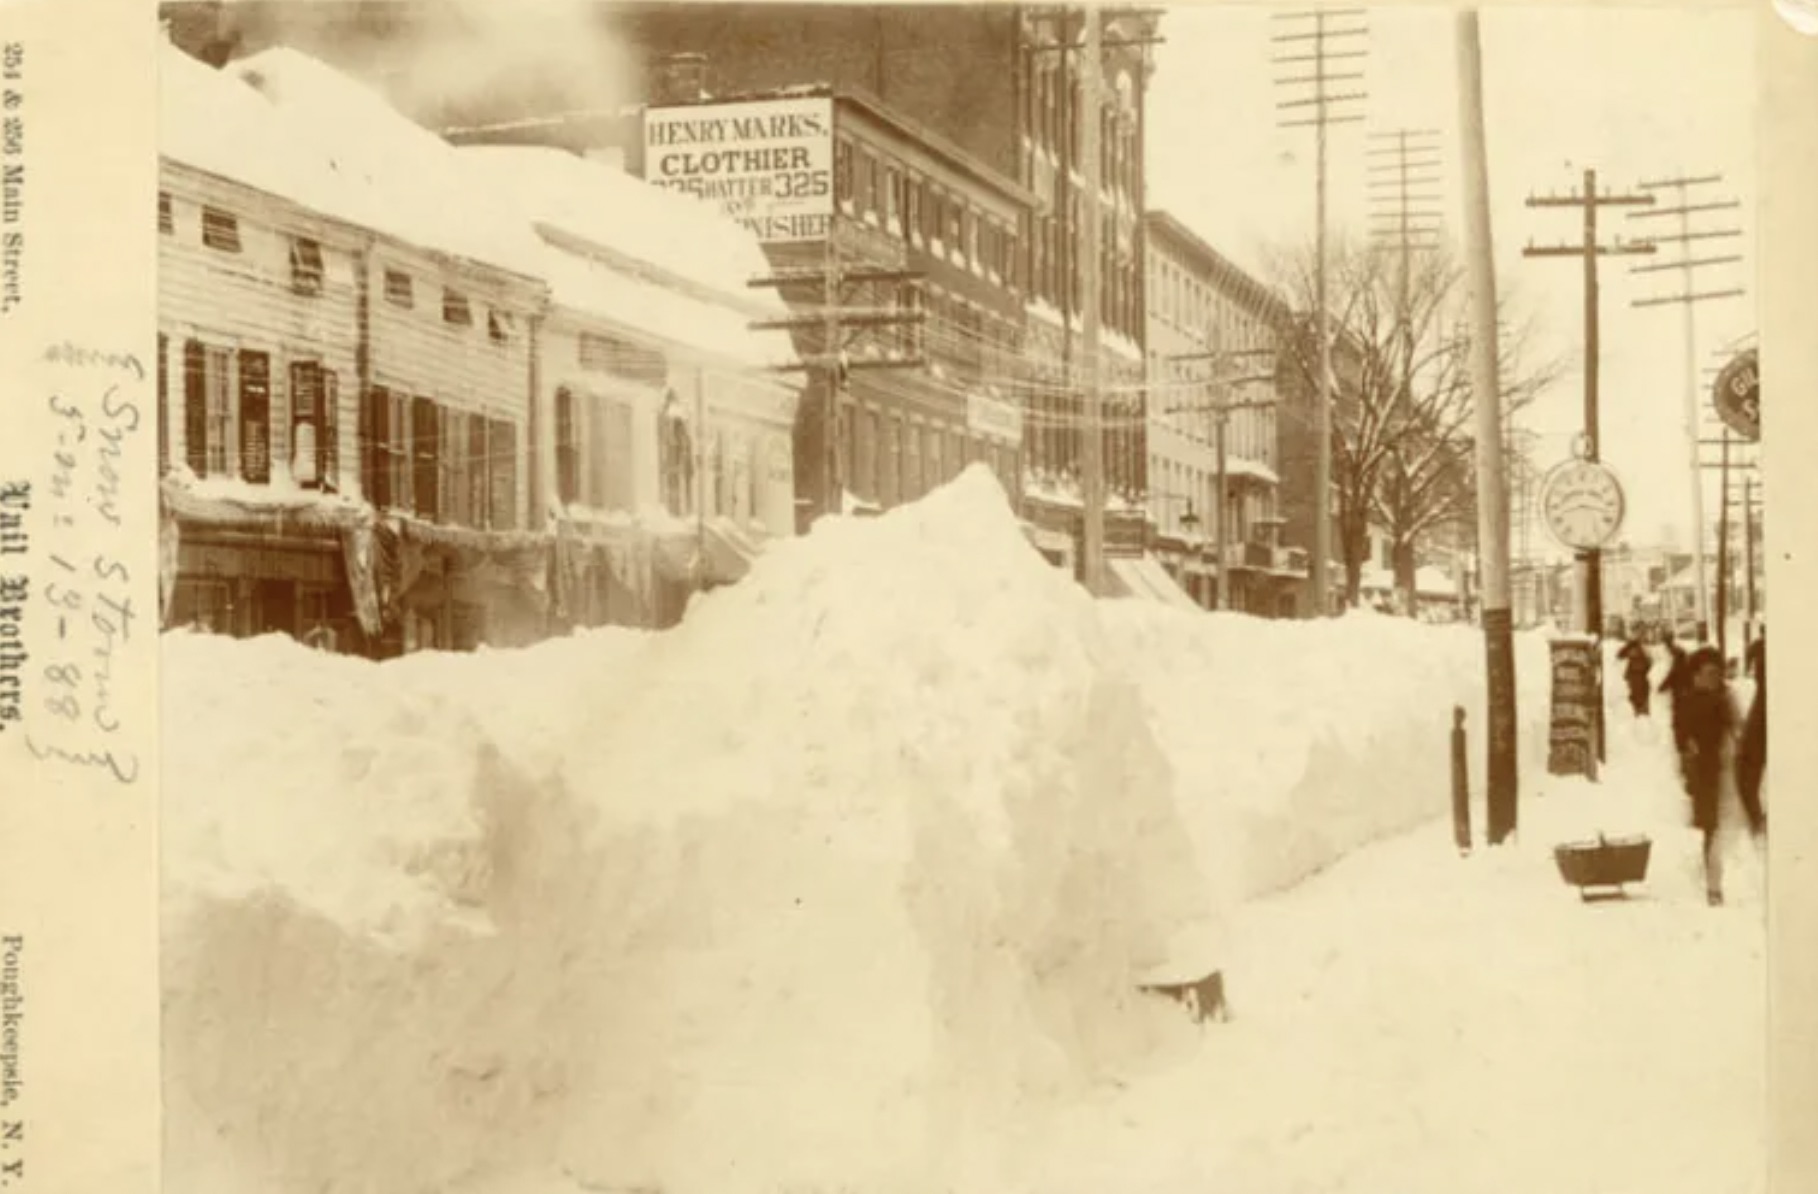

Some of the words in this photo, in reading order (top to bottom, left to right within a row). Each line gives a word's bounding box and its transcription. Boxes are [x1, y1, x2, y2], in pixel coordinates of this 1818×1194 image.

[2, 89, 23, 110] &
[649, 119, 726, 146] HENRY
[660, 146, 812, 176] CLOTHIER
[2, 164, 25, 224] Main
[705, 177, 772, 199] HATTER
[774, 170, 829, 198] 325
[2, 232, 24, 313] Street,
[96, 382, 140, 527] Snow
[0, 480, 31, 555] Vail
[0, 575, 30, 732] Brothers.
[1, 1120, 24, 1149] N.
[1, 1158, 24, 1187] Y.
